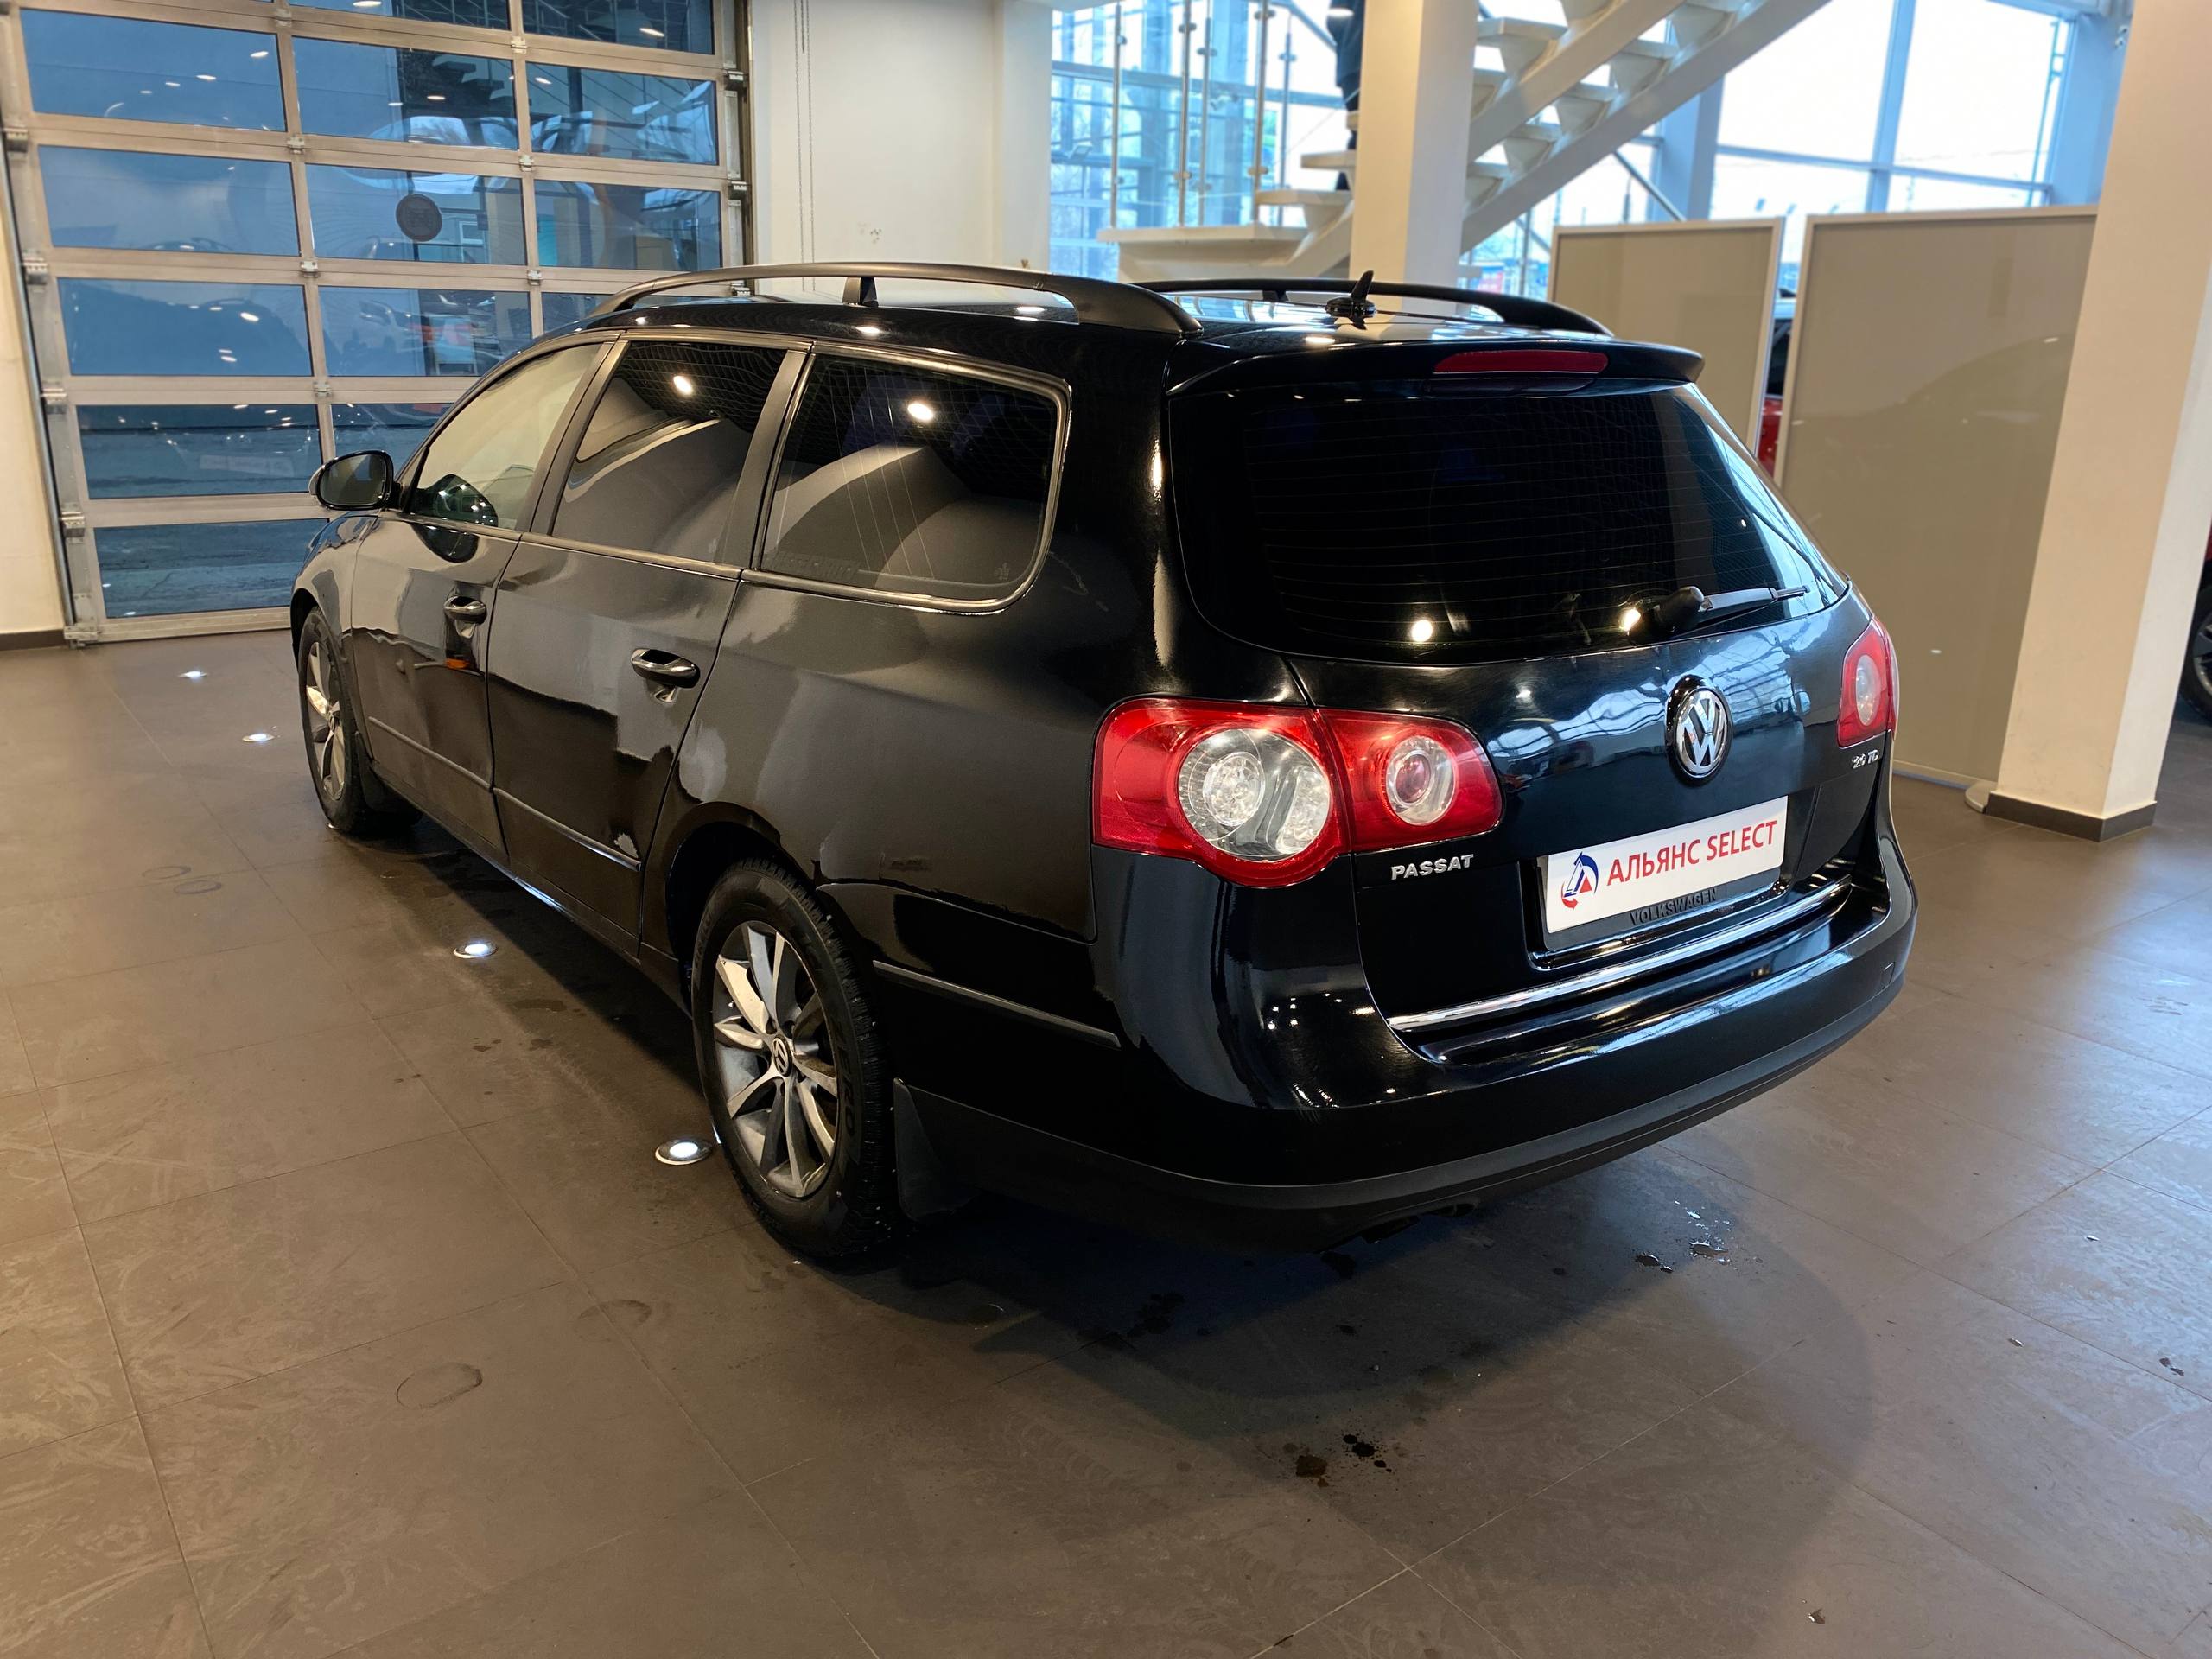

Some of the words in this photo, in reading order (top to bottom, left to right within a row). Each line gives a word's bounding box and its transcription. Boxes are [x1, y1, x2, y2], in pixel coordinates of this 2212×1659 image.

[1679, 689, 1726, 772] VW
[1390, 854, 1474, 880] PASSAT
[1607, 839, 1700, 886] АЛЬЯНС
[1707, 820, 1777, 861] SELECT
[1630, 888, 1717, 925] VOLKSWAGEN
